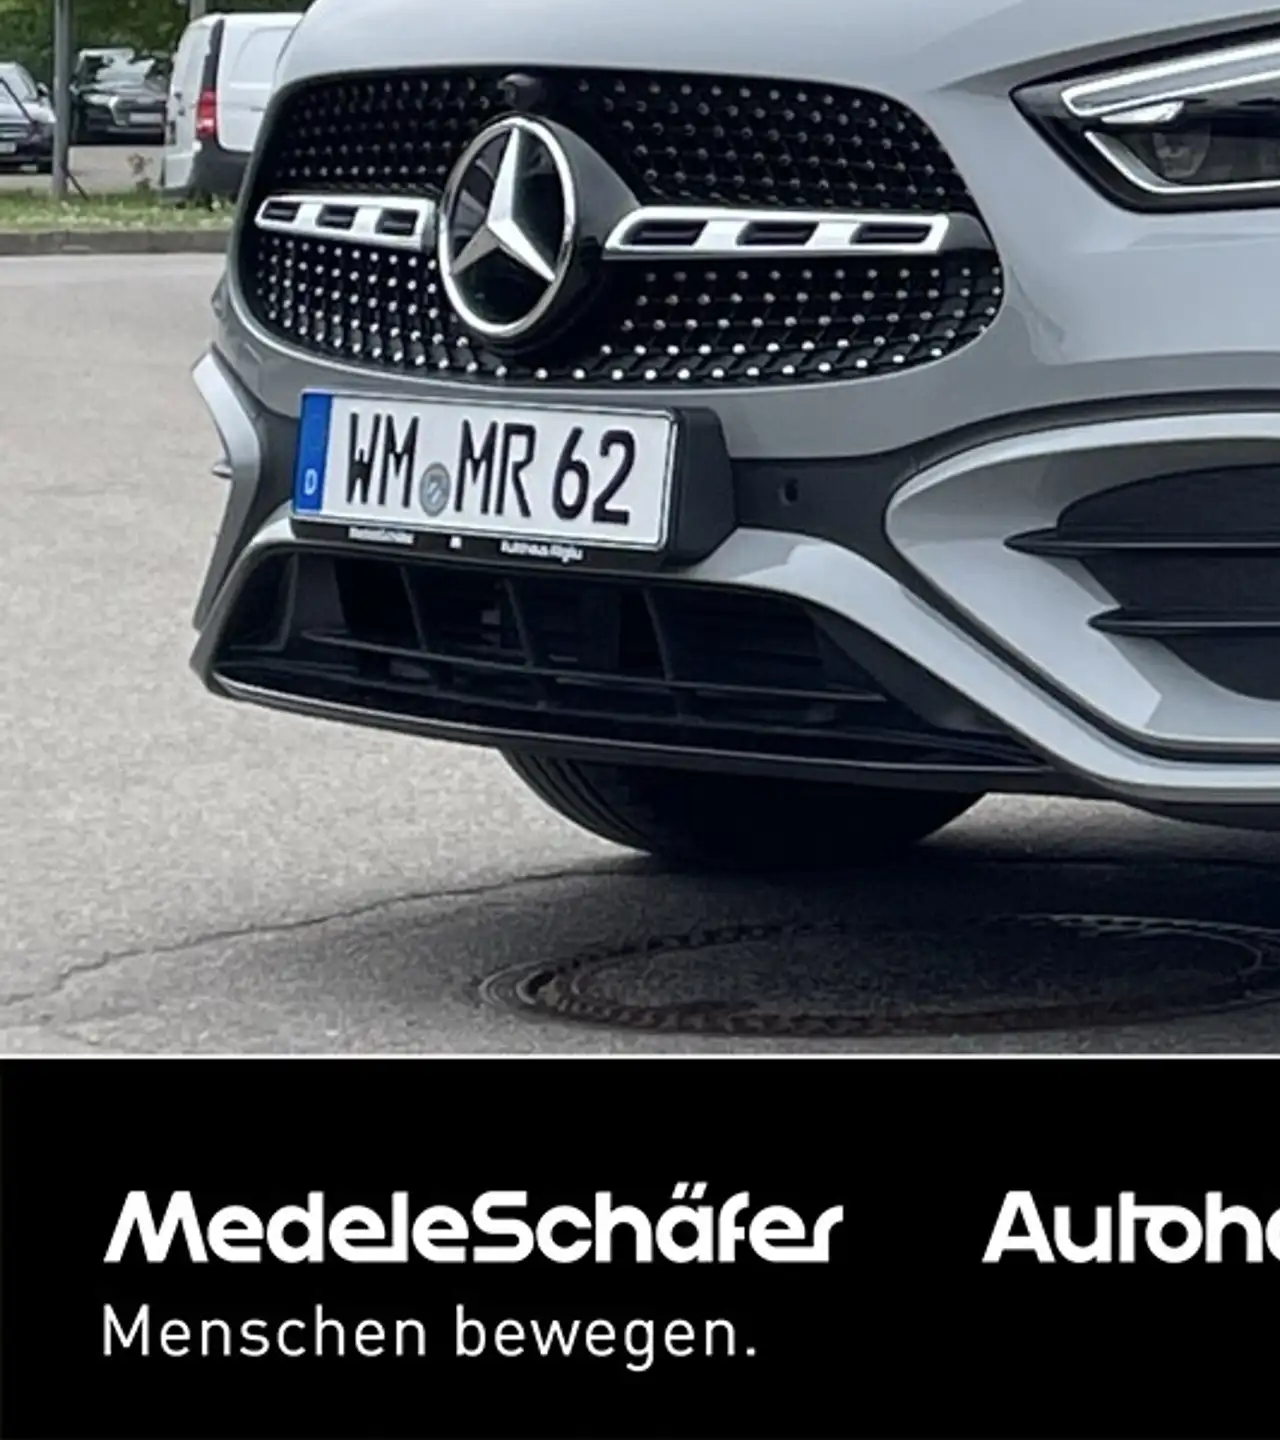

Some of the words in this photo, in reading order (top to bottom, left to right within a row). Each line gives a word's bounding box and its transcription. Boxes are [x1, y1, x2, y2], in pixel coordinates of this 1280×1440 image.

[302, 467, 318, 497] D
[345, 412, 420, 509] WM
[454, 419, 537, 518] MR
[551, 426, 637, 526] 62
